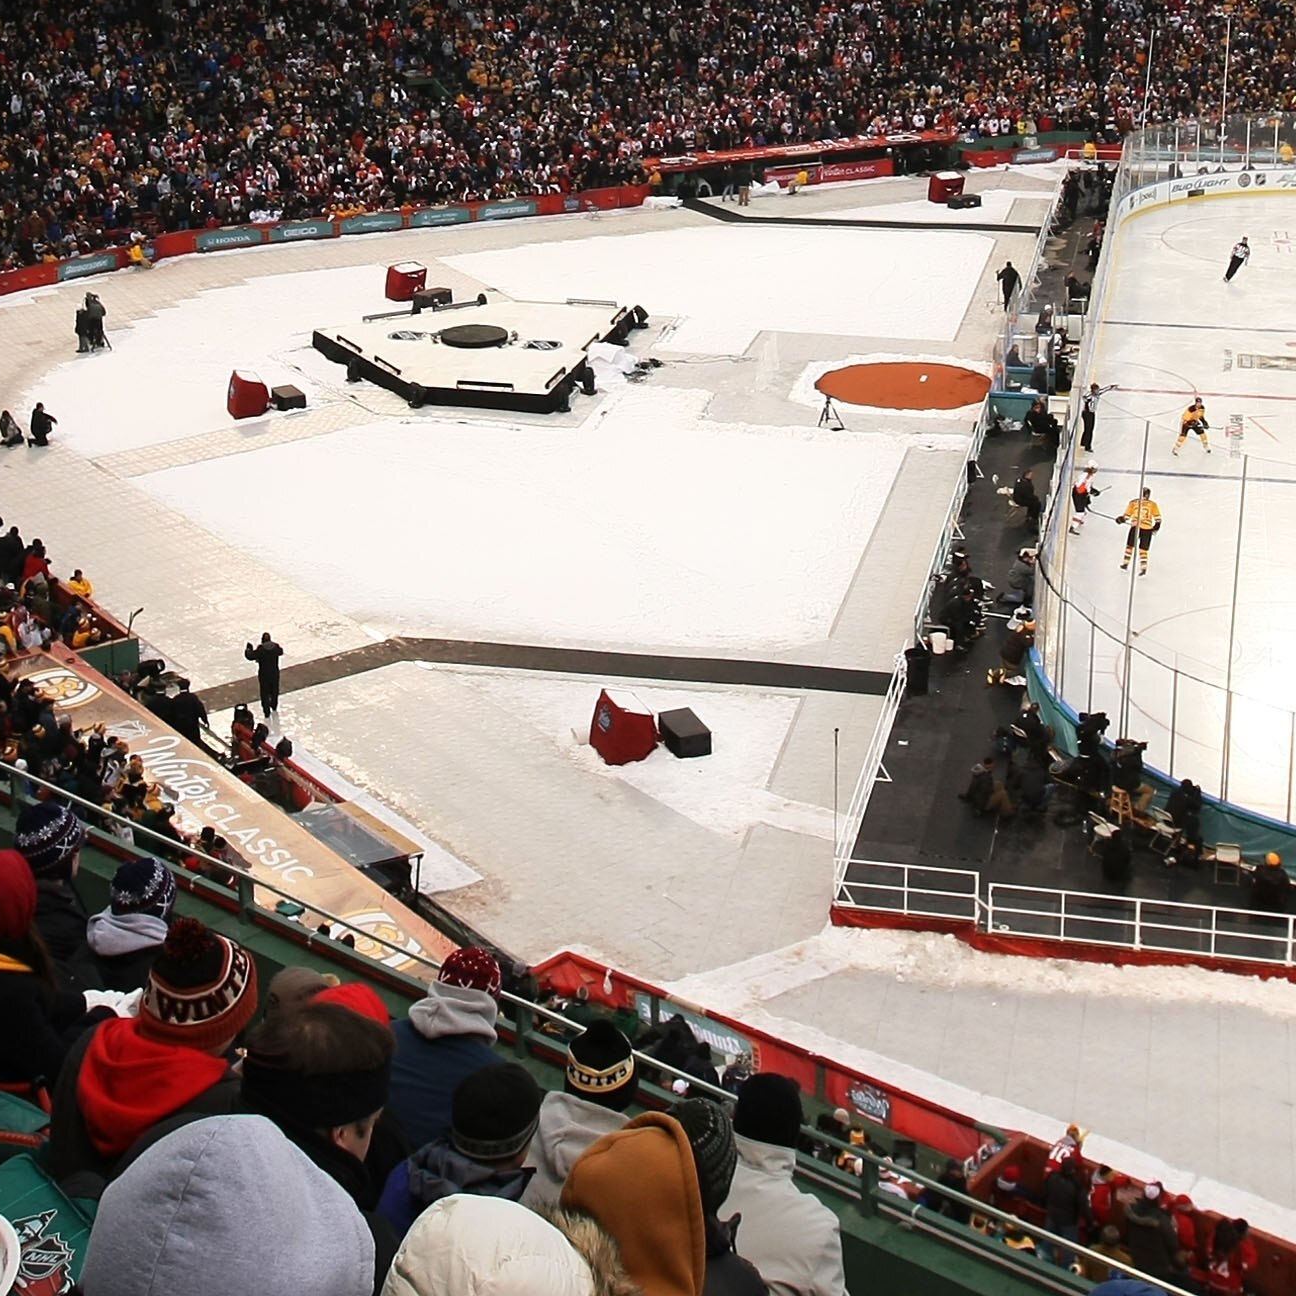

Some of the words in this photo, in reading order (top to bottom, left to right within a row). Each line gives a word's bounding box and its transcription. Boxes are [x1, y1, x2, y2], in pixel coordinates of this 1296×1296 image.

[845, 165, 876, 176] CLASSIC
[1172, 182, 1192, 193] BUD
[283, 226, 318, 237] GEICO
[215, 234, 251, 246] HONDA
[142, 735, 221, 809] Winter
[204, 804, 314, 884] CLASSIC
[25, 1251, 61, 1264] NHL
